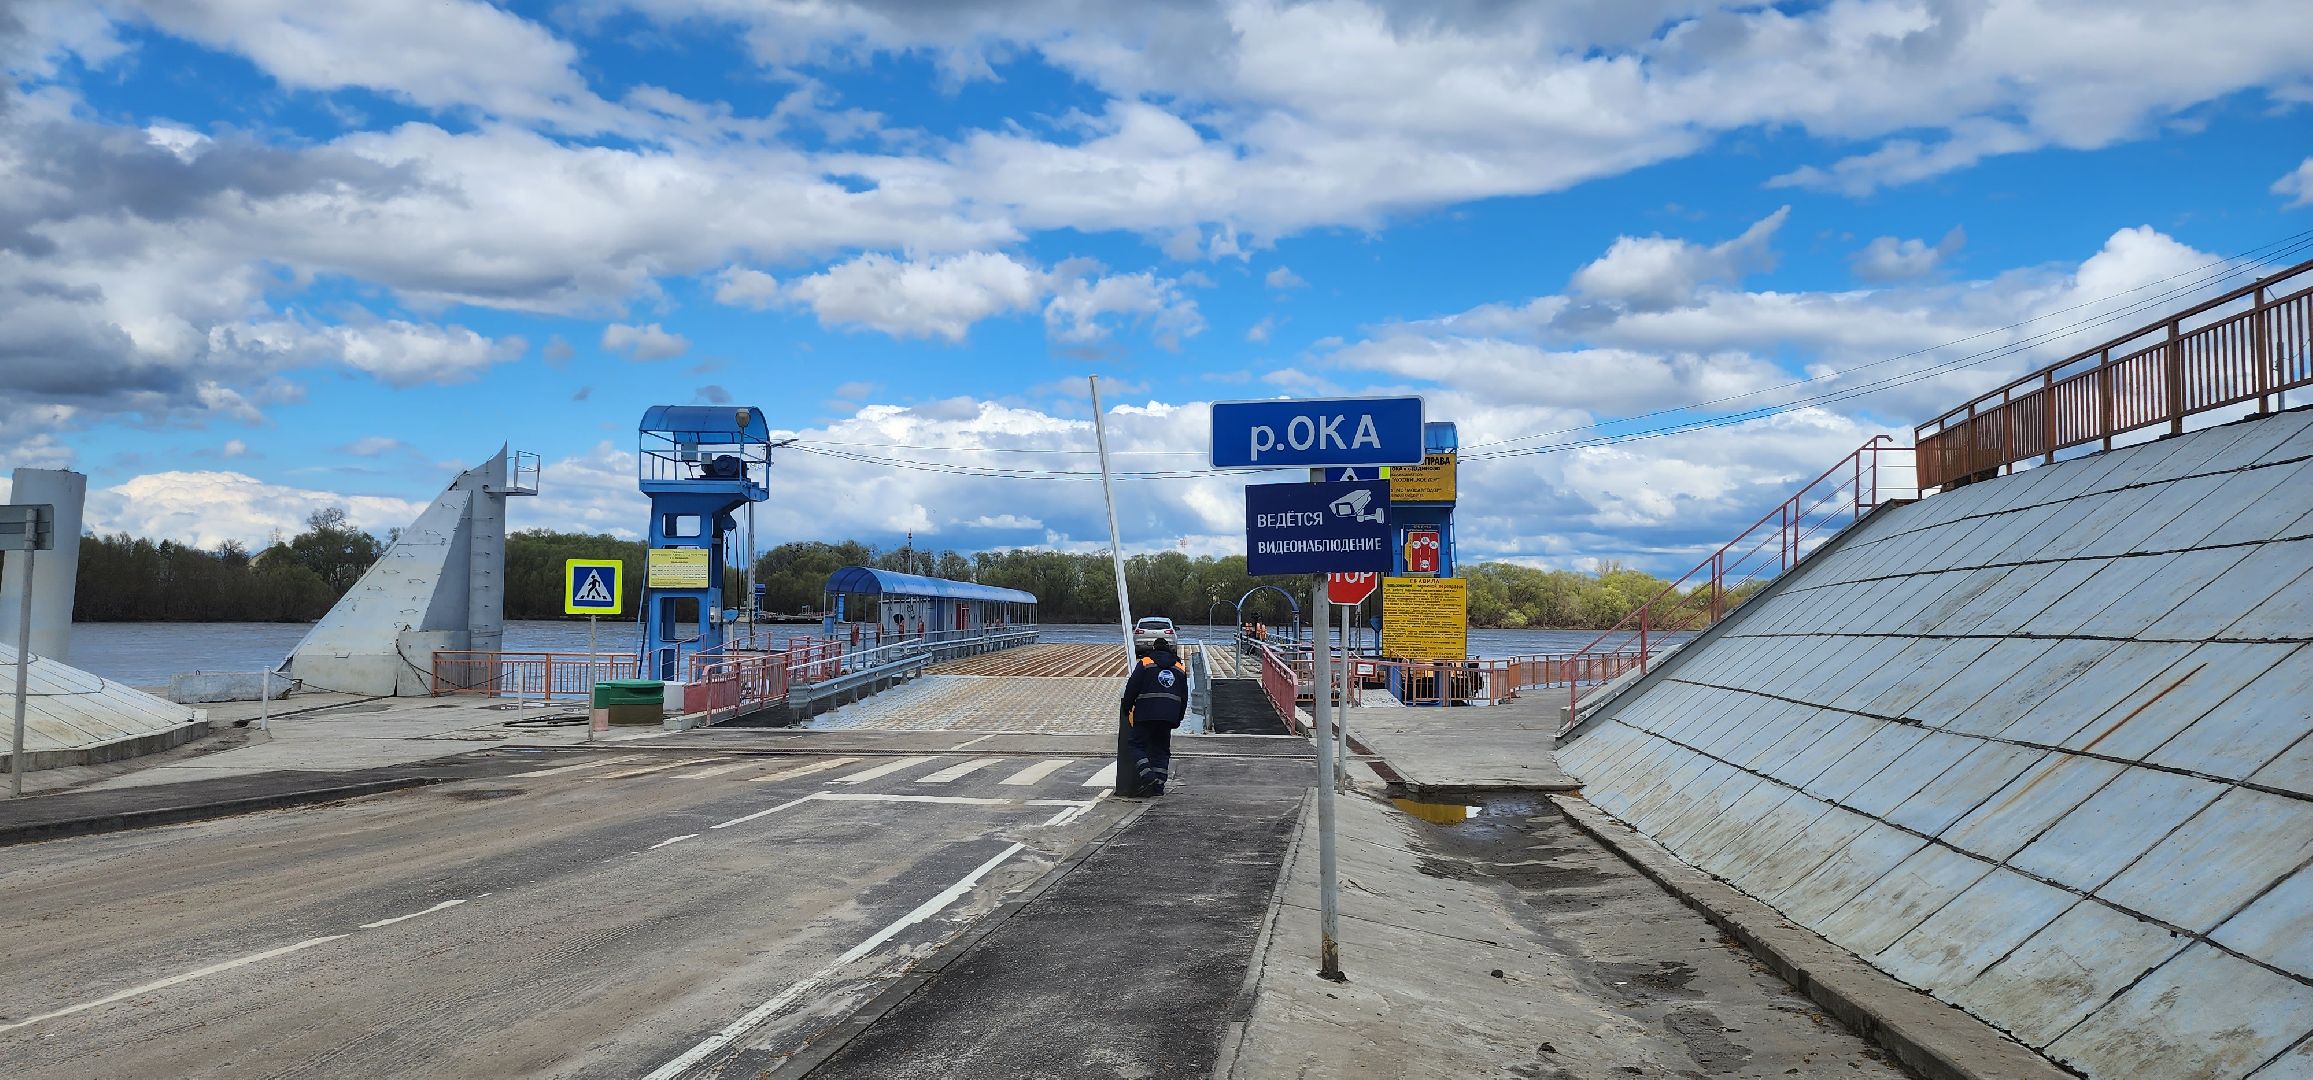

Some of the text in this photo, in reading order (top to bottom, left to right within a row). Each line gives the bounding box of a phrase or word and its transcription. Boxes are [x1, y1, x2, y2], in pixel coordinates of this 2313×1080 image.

[1251, 414, 1381, 461] р.ОКА
[1257, 511, 1323, 528] ВЕДЁТСЯ
[1258, 537, 1382, 555] ВИДЕОНАБЛЮДЕНИЕ
